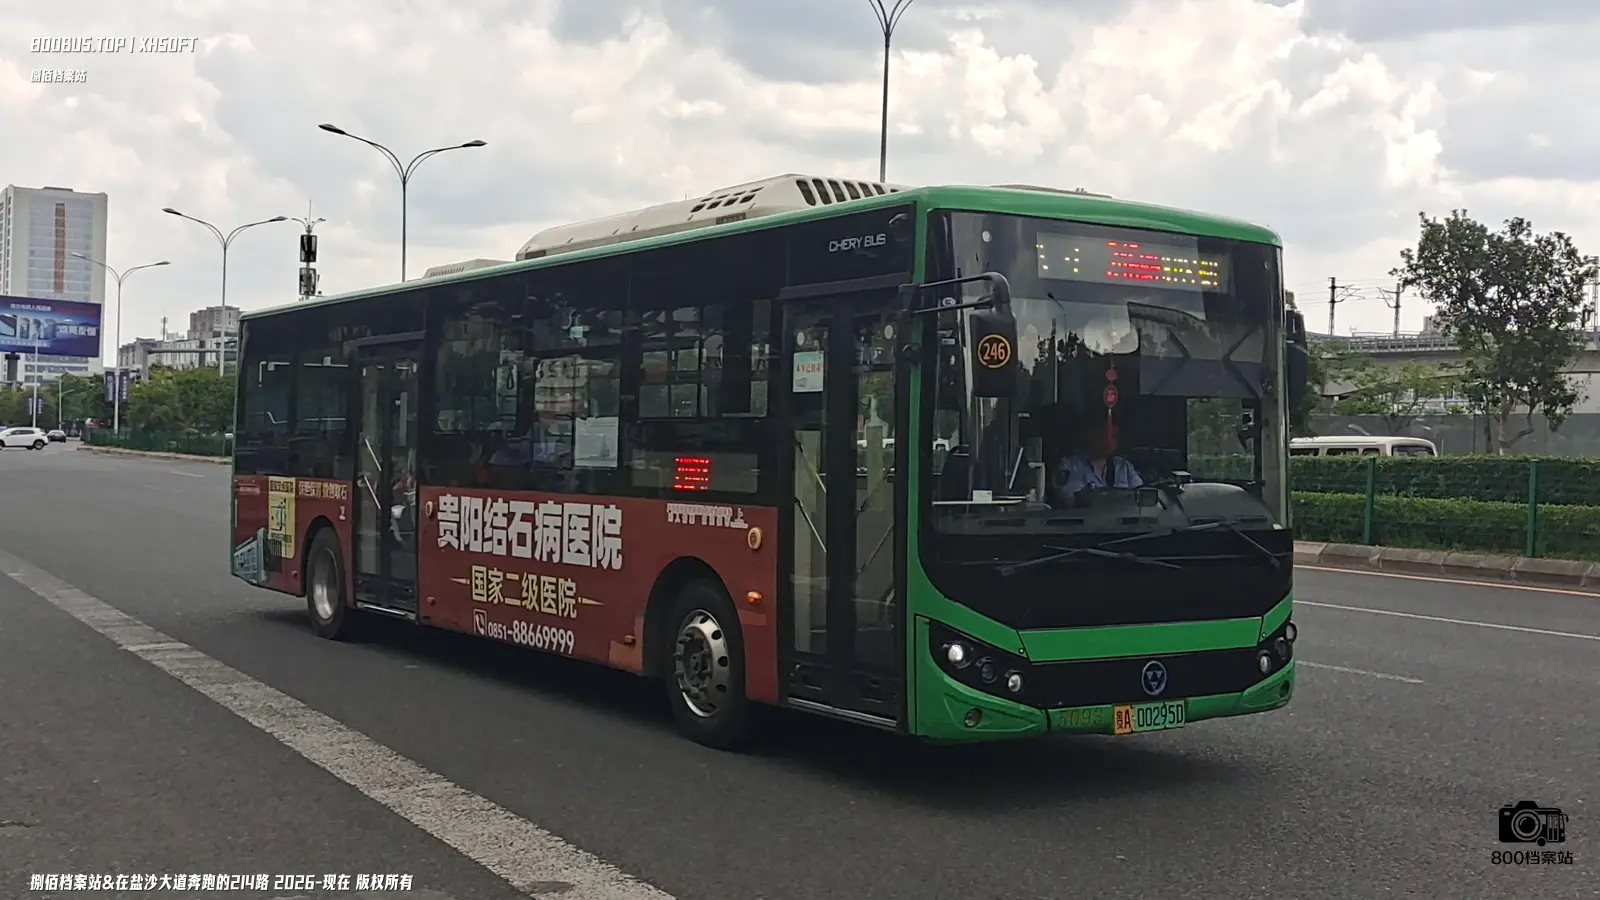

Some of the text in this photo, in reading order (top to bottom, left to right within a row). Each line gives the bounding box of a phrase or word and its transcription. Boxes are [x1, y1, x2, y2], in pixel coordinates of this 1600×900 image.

[828, 233, 887, 252] CHERY BUS
[982, 342, 1006, 361] 246
[437, 494, 623, 570] 贵阳结石病医院
[472, 565, 577, 618] 国家二级医院
[488, 619, 575, 655] 0851-88669999
